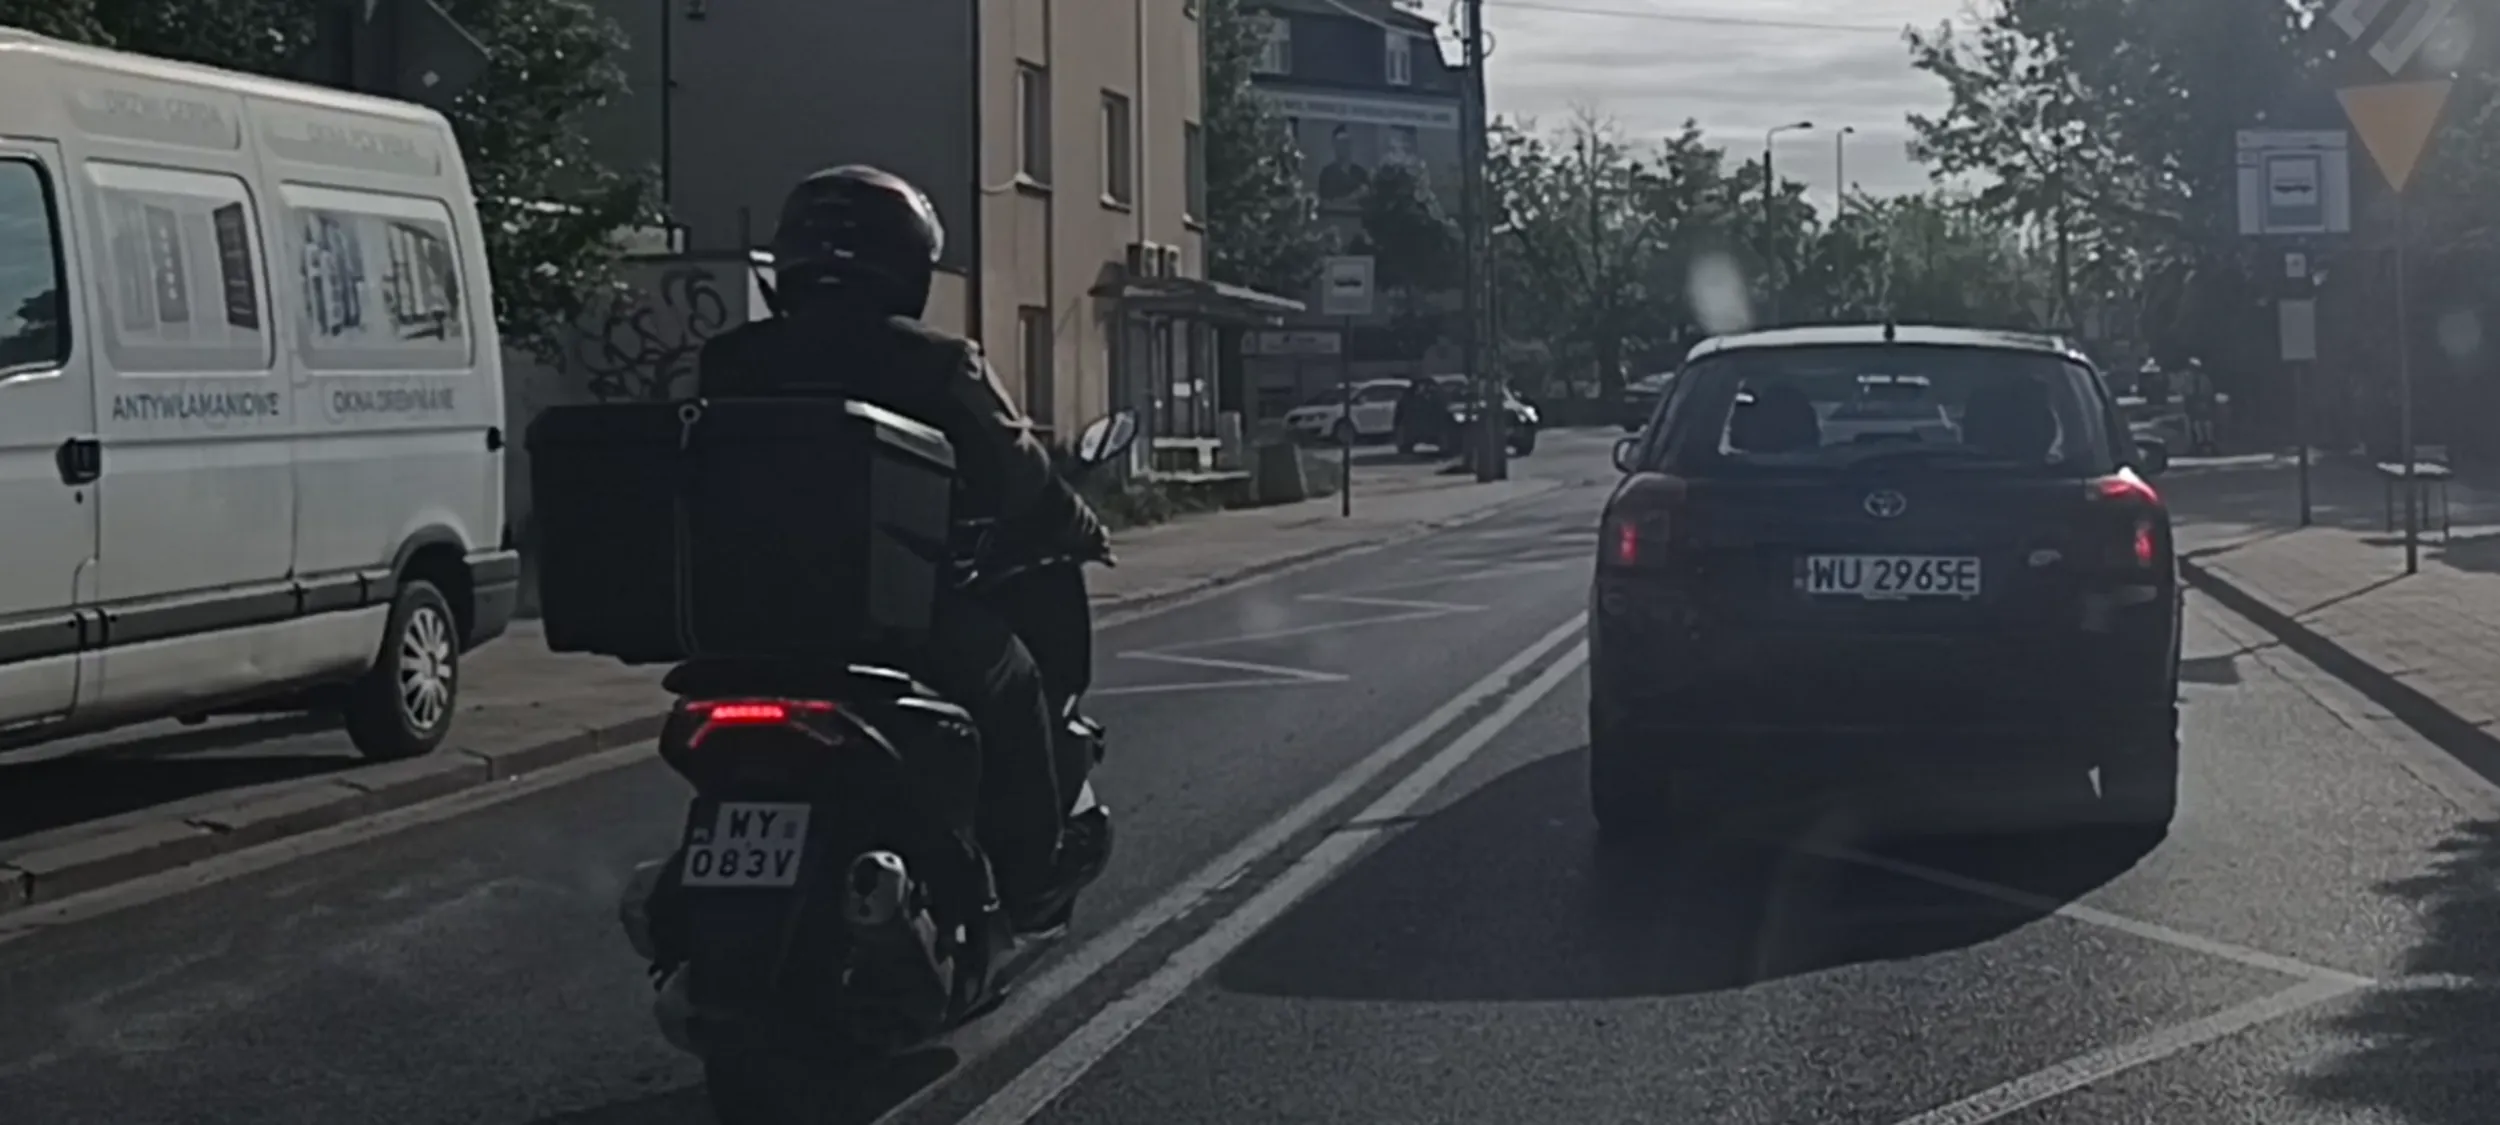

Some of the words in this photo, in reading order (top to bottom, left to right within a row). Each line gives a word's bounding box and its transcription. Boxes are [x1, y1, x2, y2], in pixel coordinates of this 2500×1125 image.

[1812, 558, 1862, 590] WU
[1873, 559, 1977, 592] 2965E
[729, 808, 778, 839] WY
[691, 848, 795, 879] 083V
